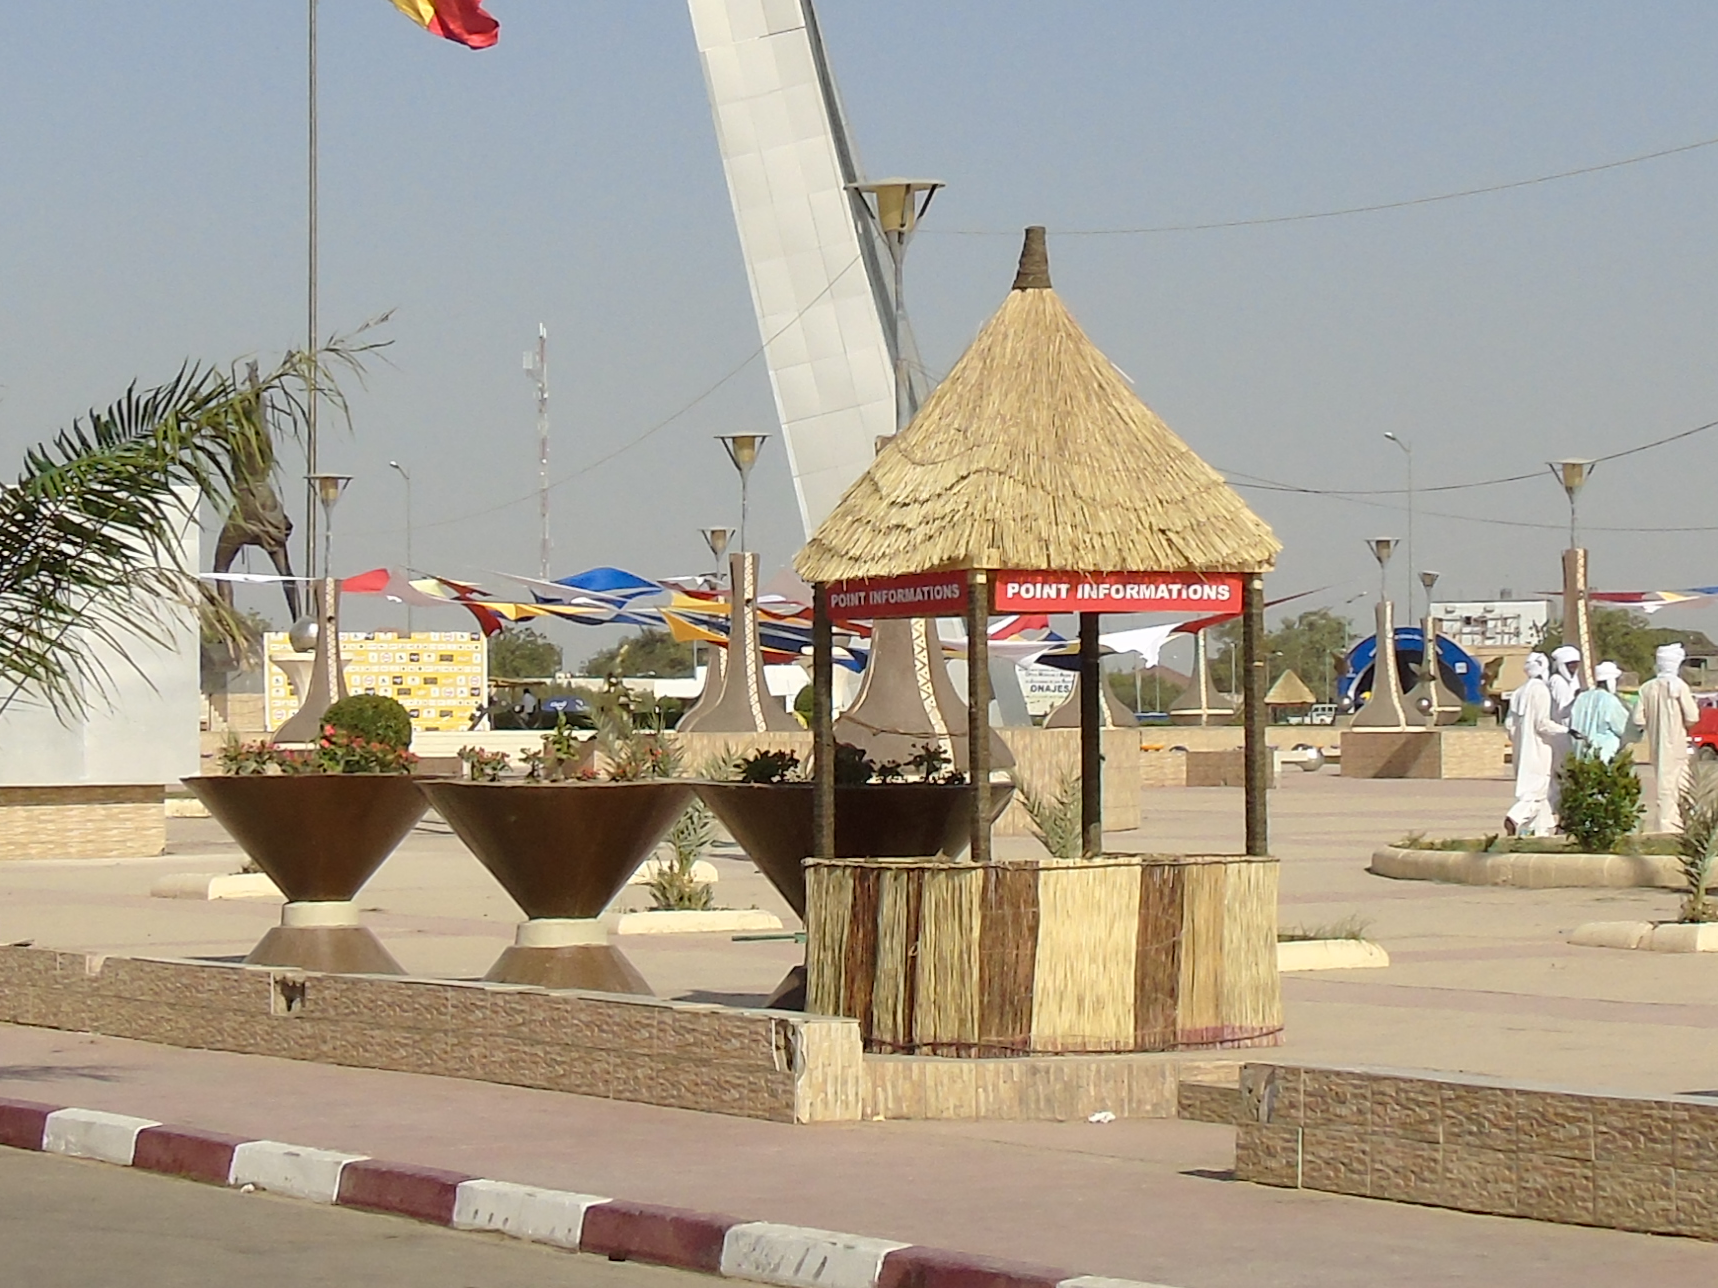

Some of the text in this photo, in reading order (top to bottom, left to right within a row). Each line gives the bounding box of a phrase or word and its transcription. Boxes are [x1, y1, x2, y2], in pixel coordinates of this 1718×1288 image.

[830, 584, 961, 608] POINT INFORMATIONS
[1007, 583, 1230, 601] POINT INFORMATIONS
